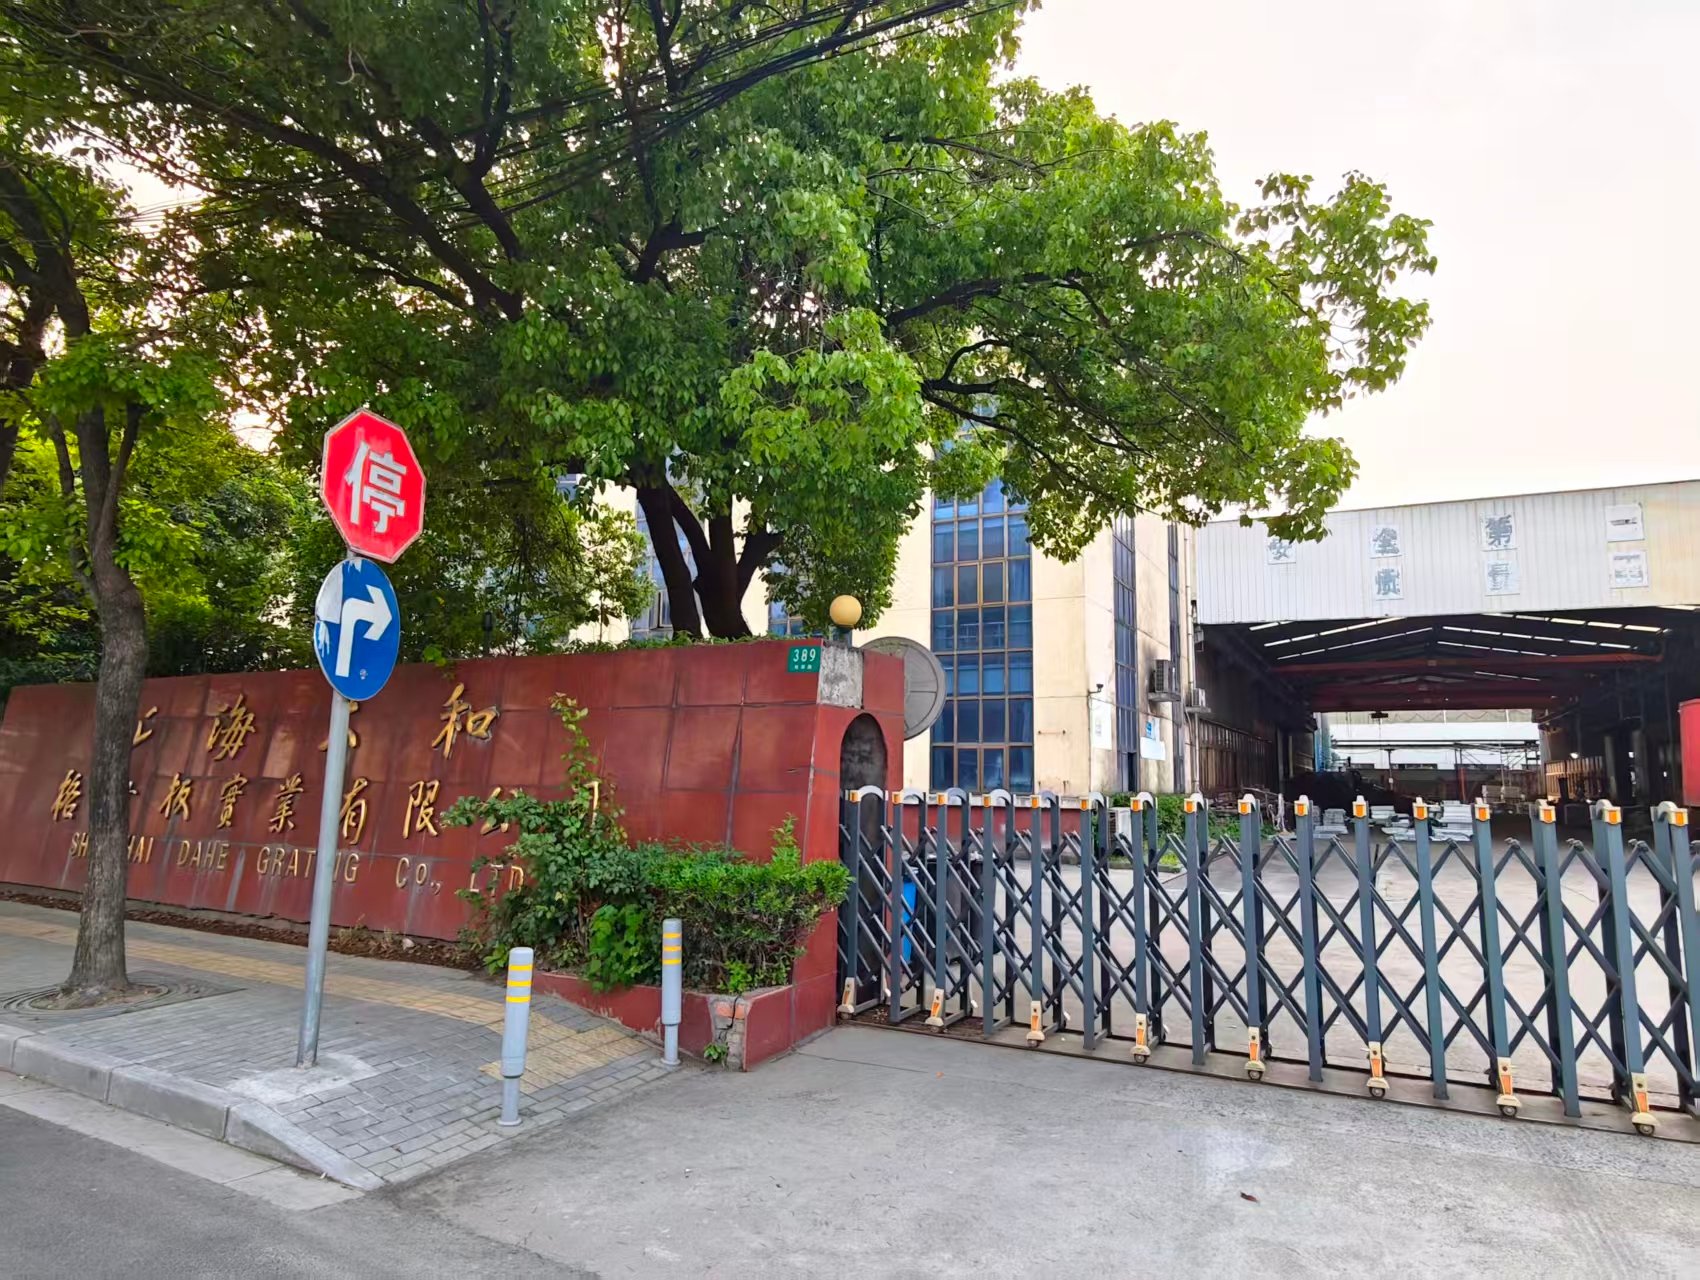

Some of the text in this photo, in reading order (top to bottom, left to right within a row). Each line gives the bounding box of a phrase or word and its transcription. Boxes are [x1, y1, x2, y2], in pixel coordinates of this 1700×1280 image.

[344, 440, 407, 533] 停
[792, 648, 816, 662] 389
[71, 832, 154, 864] SHHAI
[177, 839, 229, 869] DAHE
[256, 846, 360, 884] GRATG
